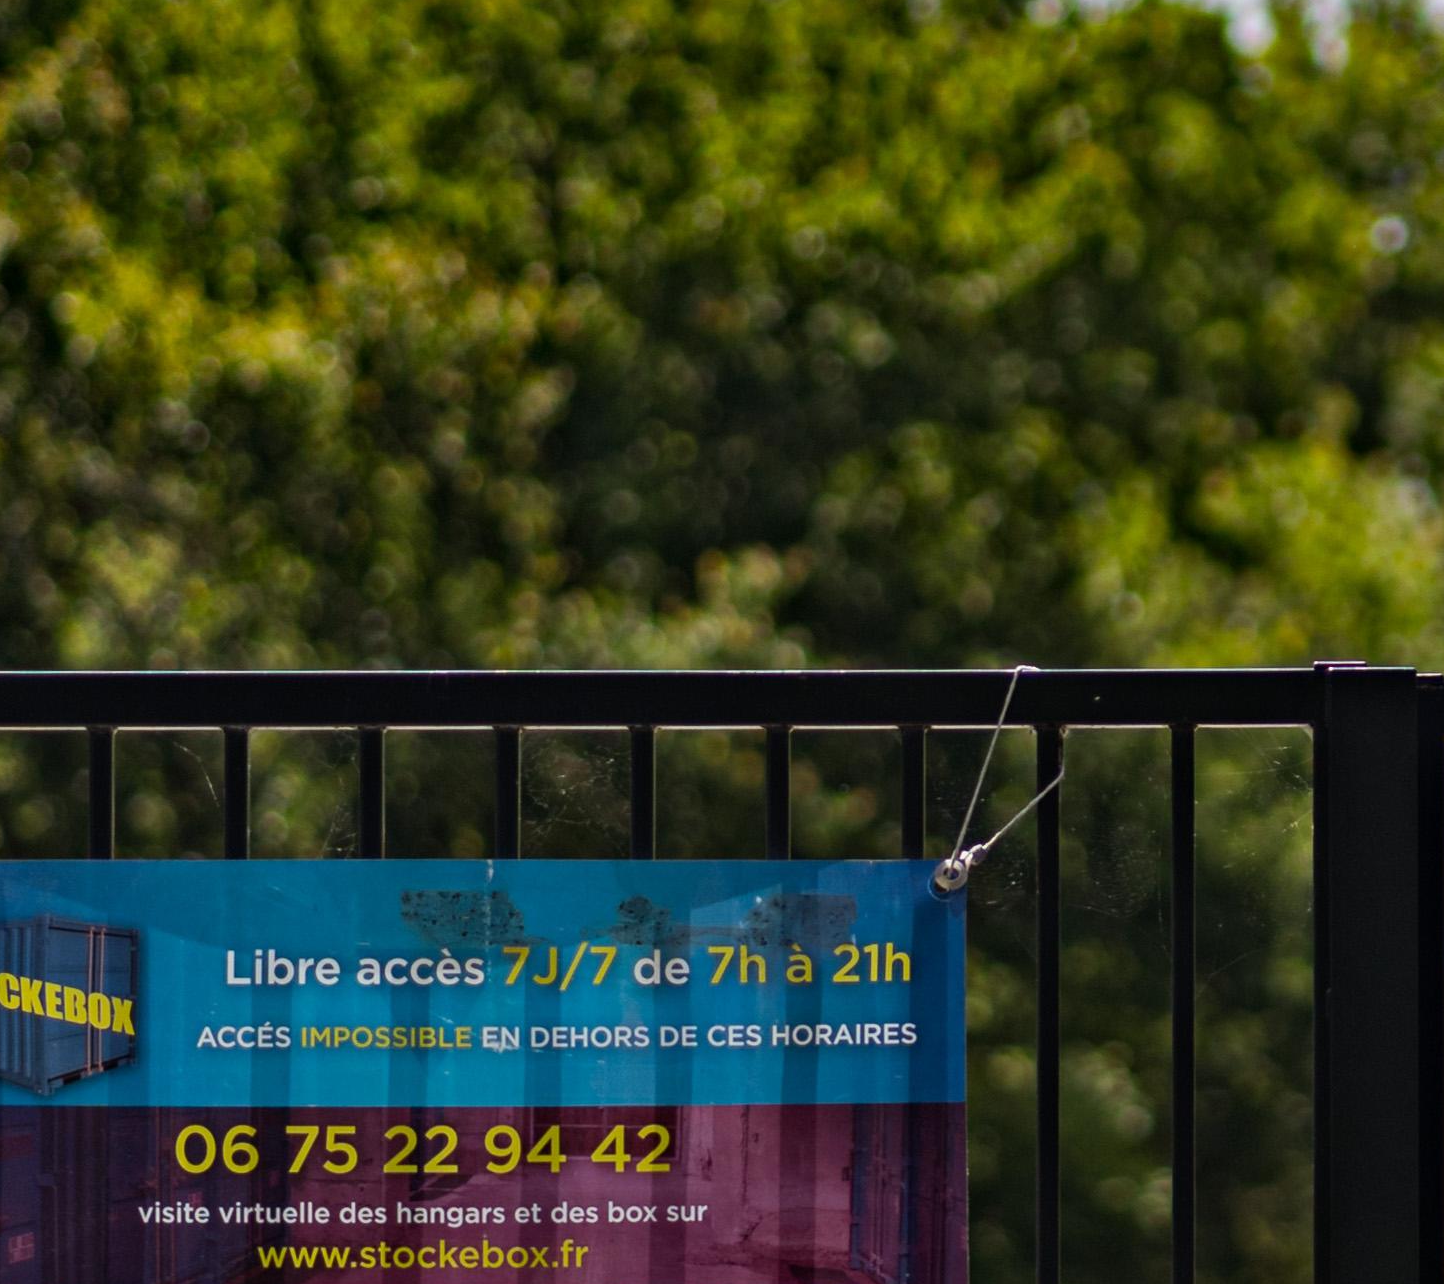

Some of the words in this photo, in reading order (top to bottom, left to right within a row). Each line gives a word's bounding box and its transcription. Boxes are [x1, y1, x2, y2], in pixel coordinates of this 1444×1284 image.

[226, 949, 341, 985] Libre
[356, 948, 485, 985] accès
[502, 941, 617, 991] 7J/7
[633, 948, 690, 984] de
[707, 945, 767, 984] 7h
[785, 944, 813, 983] à
[832, 942, 911, 983] 21h
[197, 1021, 291, 1049] ACCÉS
[300, 1025, 472, 1049] IMPOSSIBLE
[482, 1025, 520, 1049] EN
[530, 1025, 650, 1048] DEHORS
[660, 1025, 698, 1048] DE
[707, 1024, 763, 1047] CES
[771, 1023, 918, 1046] HORAIRES
[175, 1124, 260, 1174] 06
[285, 1124, 359, 1174] 75
[382, 1124, 459, 1174] 22
[484, 1124, 567, 1174] 94
[590, 1124, 671, 1173] 42
[138, 1202, 210, 1225] visite
[219, 1201, 330, 1224] virtuelle
[339, 1201, 387, 1224] des
[396, 1201, 505, 1229] hangars
[514, 1203, 542, 1224] et
[551, 1201, 599, 1224] des
[607, 1200, 657, 1223] box
[666, 1205, 708, 1223] sur
[258, 1240, 589, 1269] www.stockebox.fr
